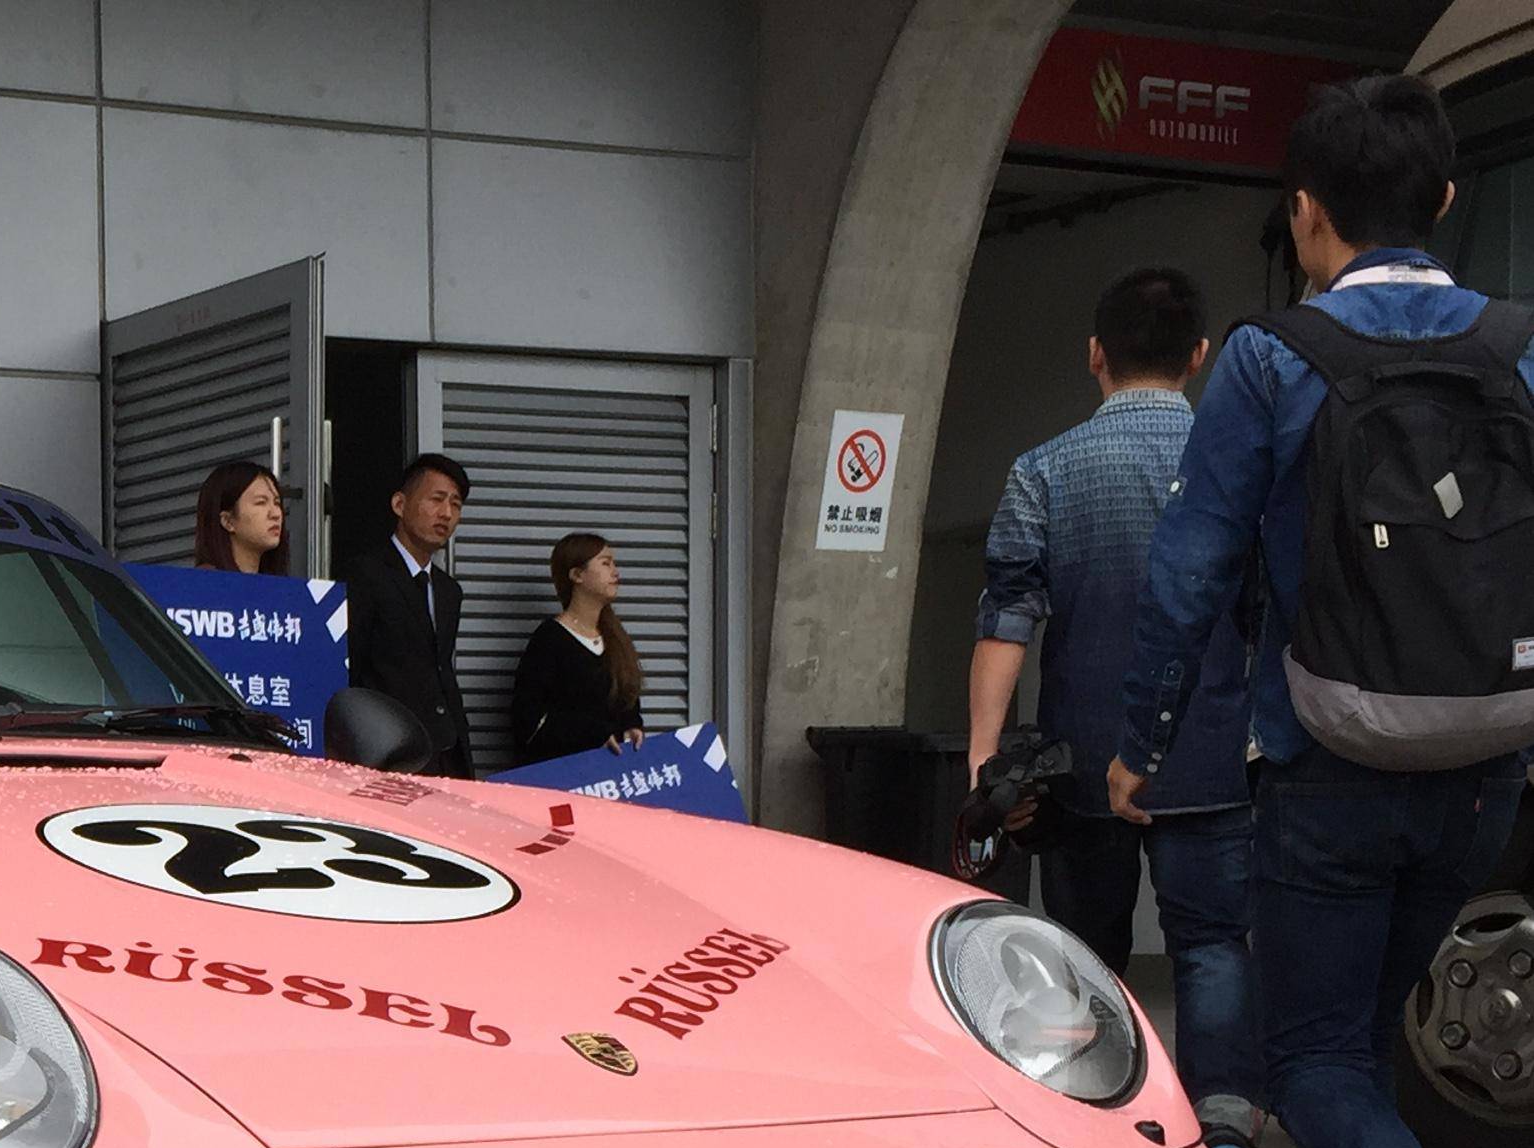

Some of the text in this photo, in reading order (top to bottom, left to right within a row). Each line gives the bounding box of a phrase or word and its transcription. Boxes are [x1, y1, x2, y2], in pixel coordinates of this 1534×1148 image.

[1138, 75, 1251, 118] FFF
[824, 524, 880, 535] NO SMOKING
[827, 504, 883, 523] 禁止吸烟
[566, 779, 620, 801] WB
[71, 819, 491, 895] 23
[30, 937, 512, 1048] RÜSSEL
[613, 928, 791, 1041] RÜSSEL
